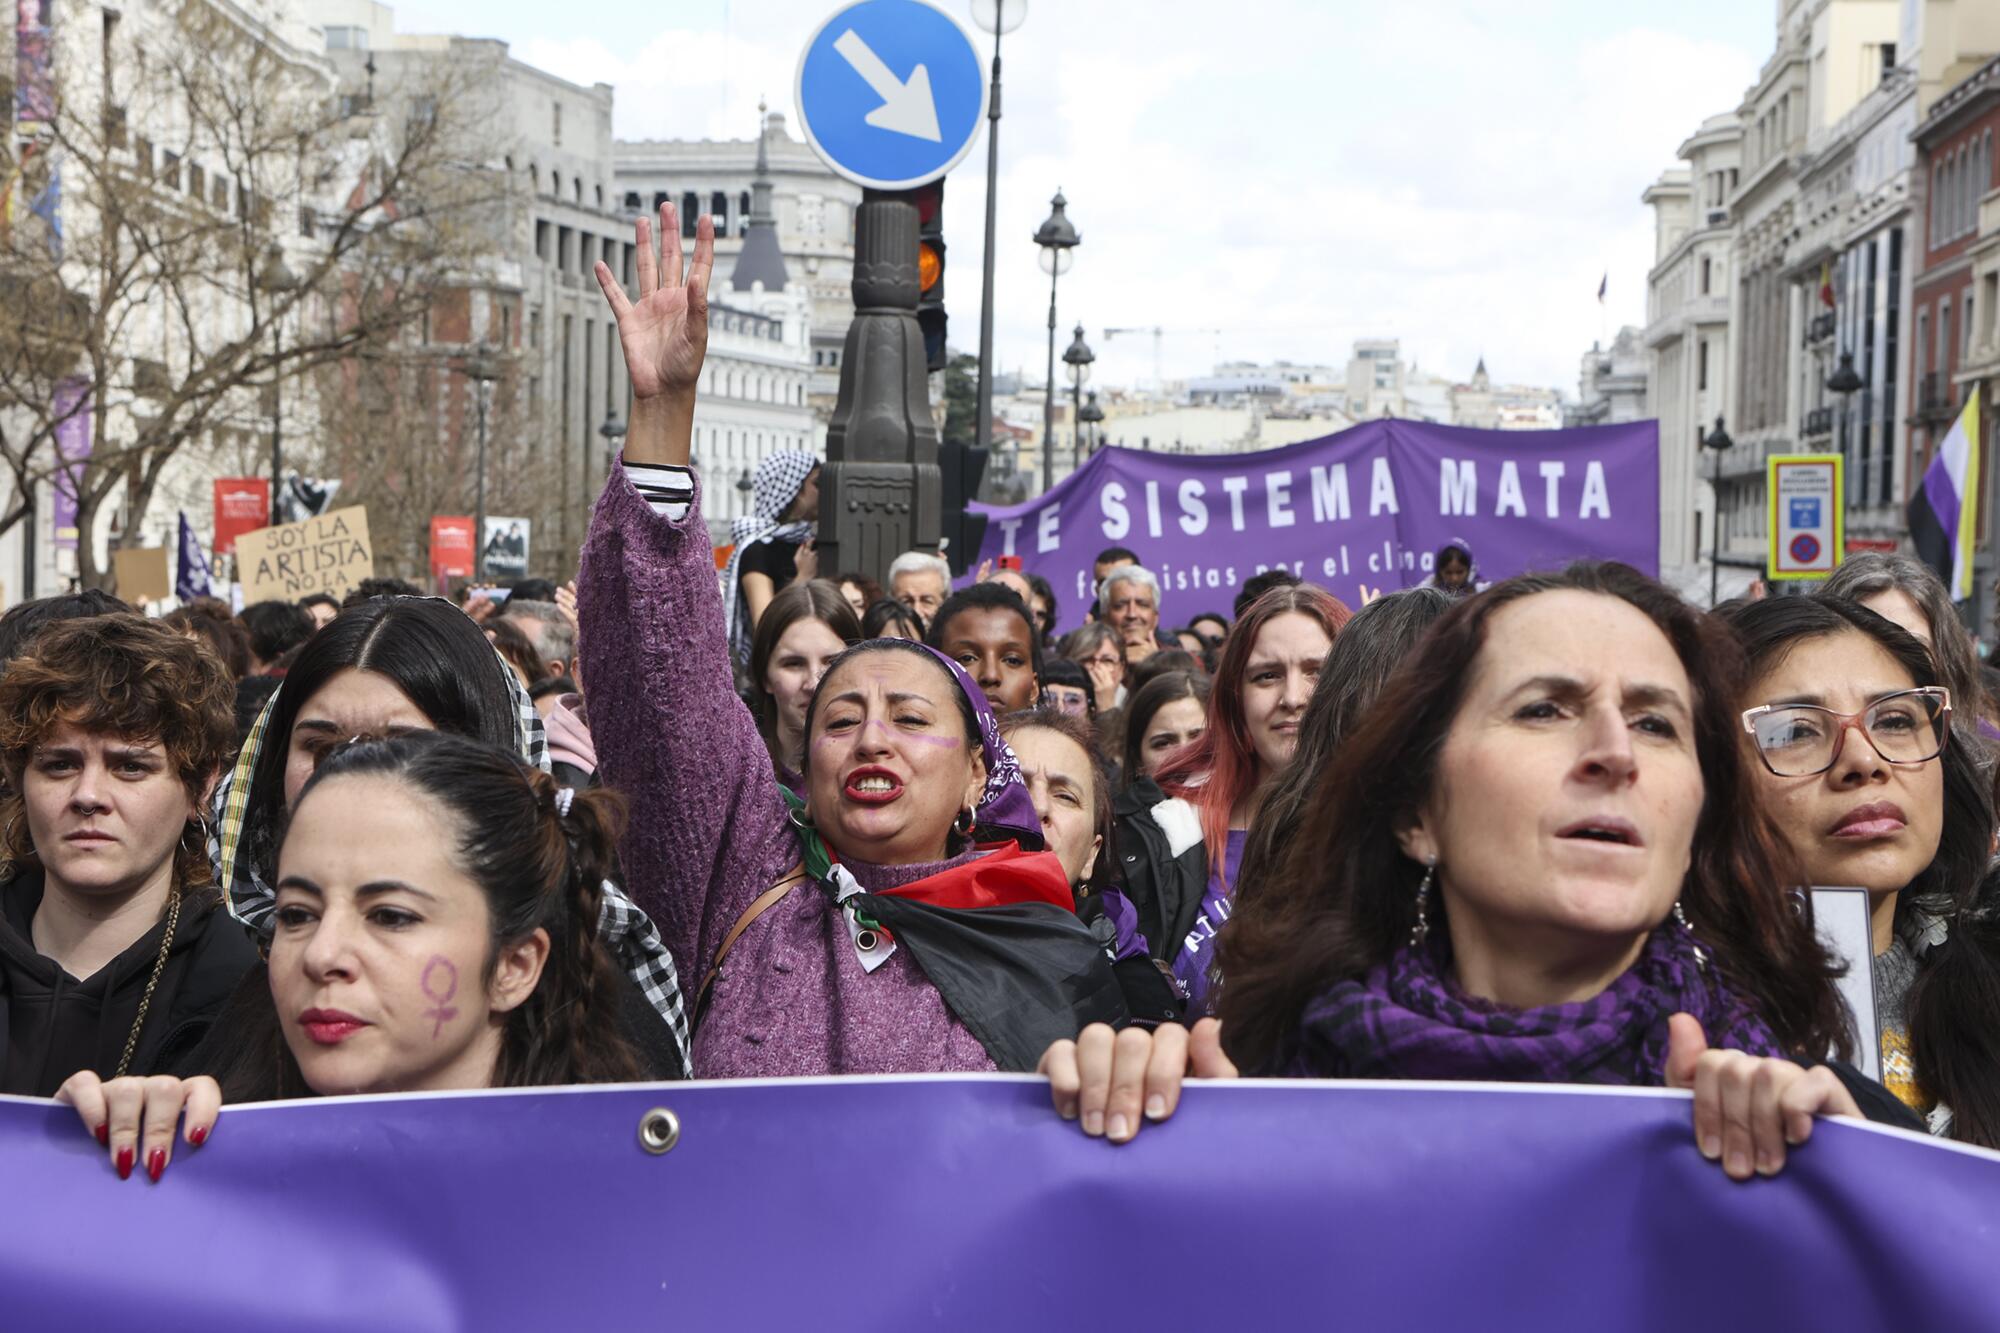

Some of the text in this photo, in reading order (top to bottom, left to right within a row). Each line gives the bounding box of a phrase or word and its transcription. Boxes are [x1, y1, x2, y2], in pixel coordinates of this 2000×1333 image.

[1101, 456, 1399, 540] SISTEMA
[1440, 457, 1611, 519] MATA
[266, 515, 349, 550] SOY LA
[255, 539, 369, 585] ARTISTA
[1323, 545, 1350, 577] el
[286, 570, 348, 595] NO LA
